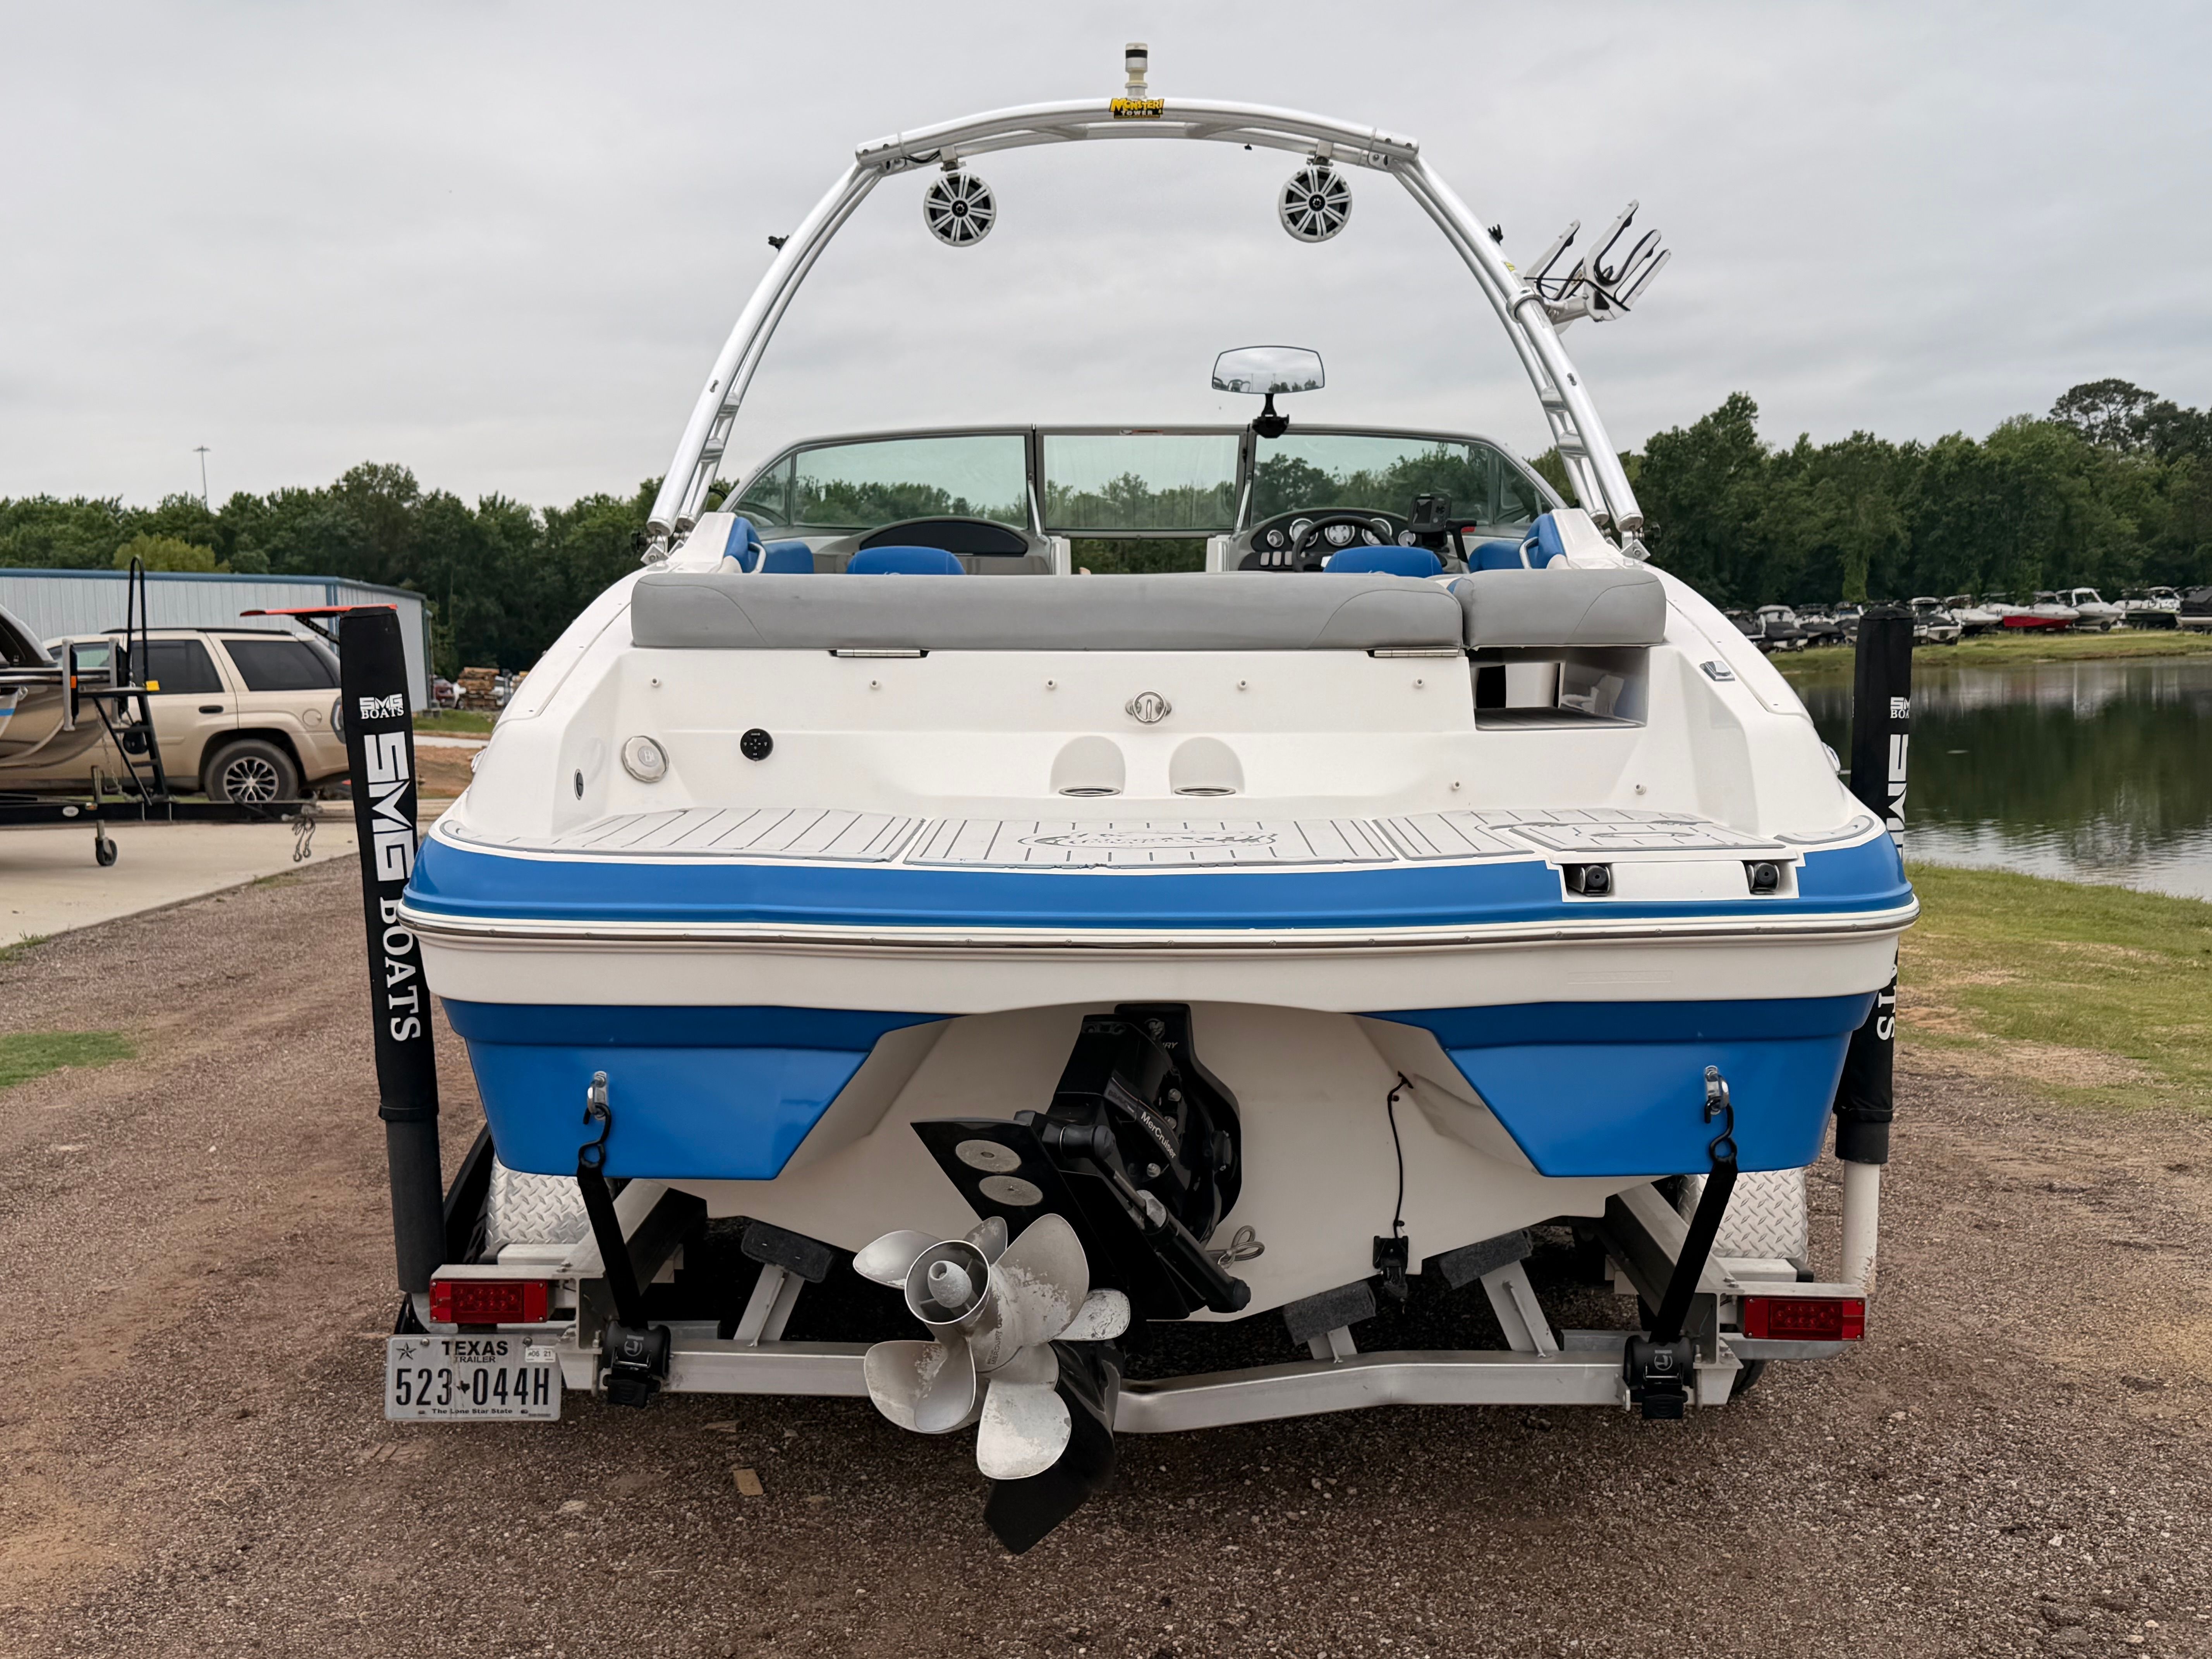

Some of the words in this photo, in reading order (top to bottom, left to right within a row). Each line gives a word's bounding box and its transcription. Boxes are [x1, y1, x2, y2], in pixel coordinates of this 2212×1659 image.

[359, 694, 403, 710] SMG
[1890, 697, 1911, 712] SM
[361, 706, 404, 719] BOATS
[364, 731, 414, 881] SMG
[1141, 1111, 1176, 1158] MerCruiser
[441, 1341, 508, 1355] TEXAS
[396, 1368, 452, 1405] 523
[472, 1368, 550, 1405] 044H
